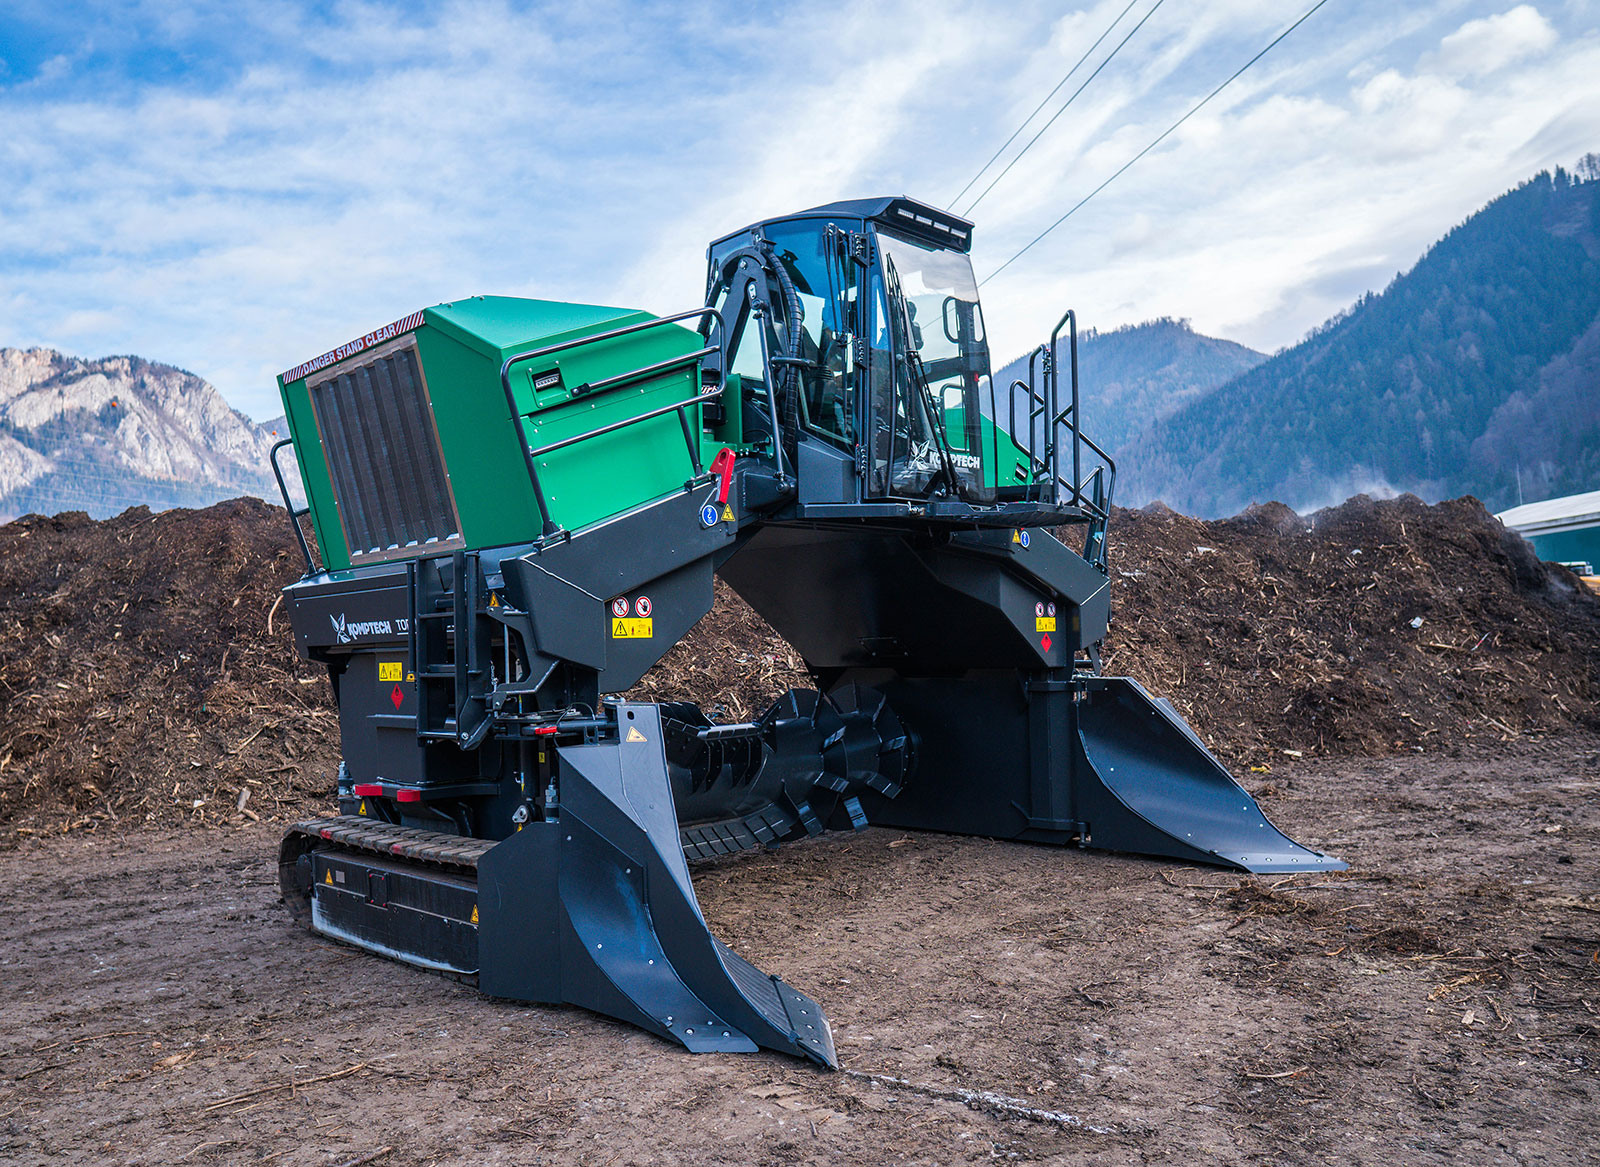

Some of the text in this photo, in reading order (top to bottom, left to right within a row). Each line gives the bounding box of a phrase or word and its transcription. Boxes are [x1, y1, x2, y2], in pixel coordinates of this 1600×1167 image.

[303, 324, 396, 375] DANGER STAND CLEAR
[347, 620, 392, 639] KOMPTECH
